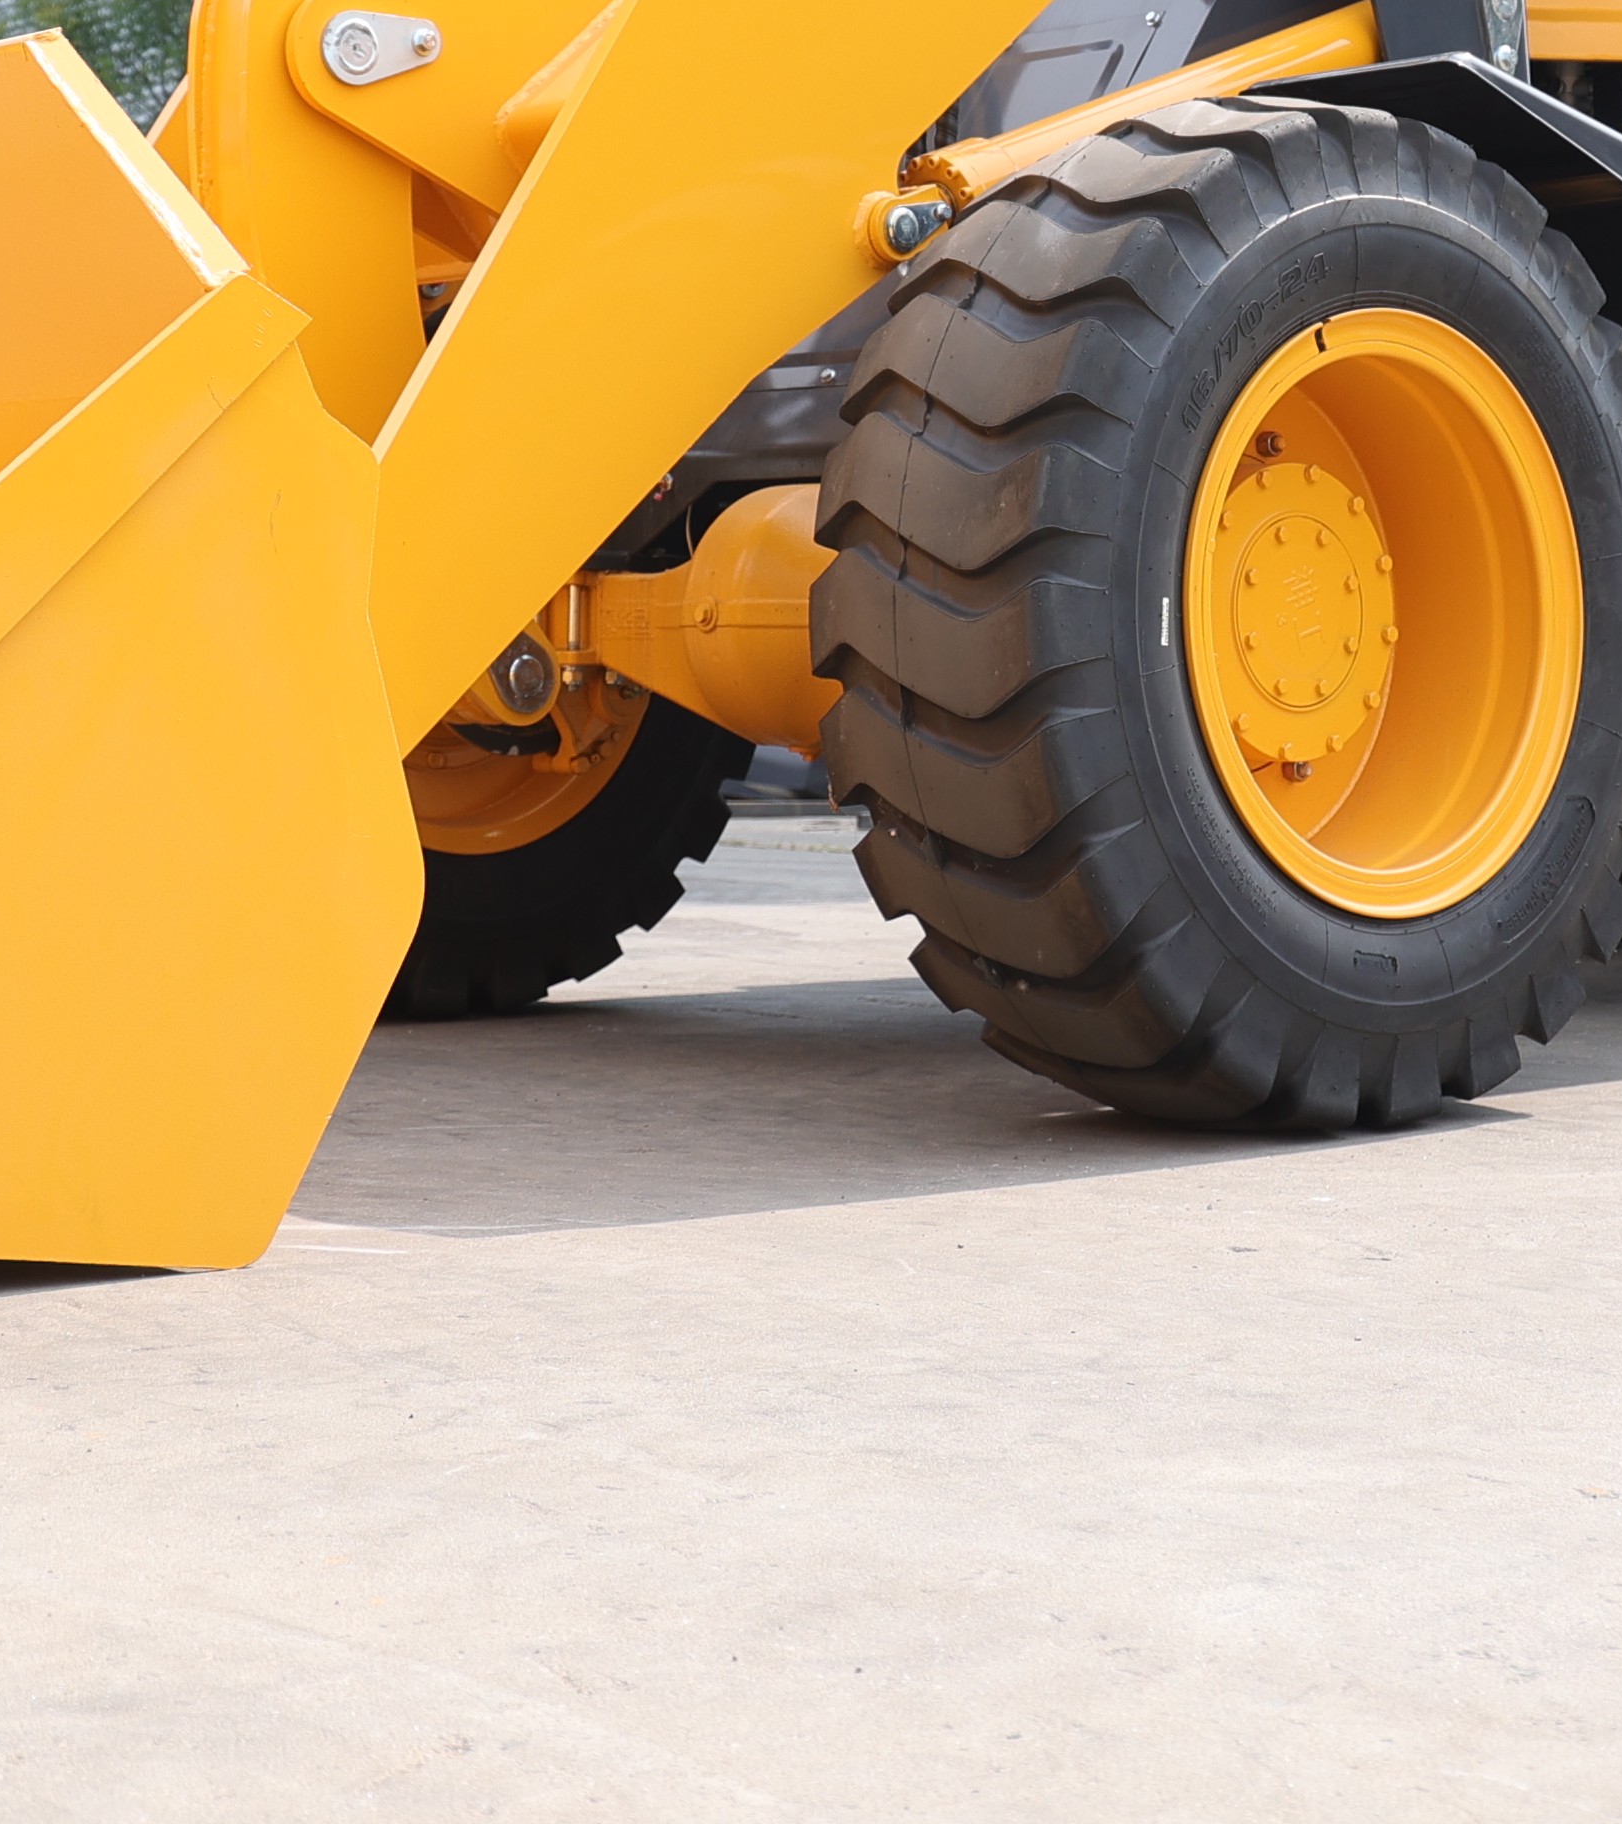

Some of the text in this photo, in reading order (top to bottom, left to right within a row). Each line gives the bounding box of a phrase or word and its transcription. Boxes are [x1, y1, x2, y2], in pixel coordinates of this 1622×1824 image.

[1182, 251, 1328, 430] 16/70-24
[1557, 817, 1586, 870] DOUBLE
[1504, 890, 1540, 929] HORSE
